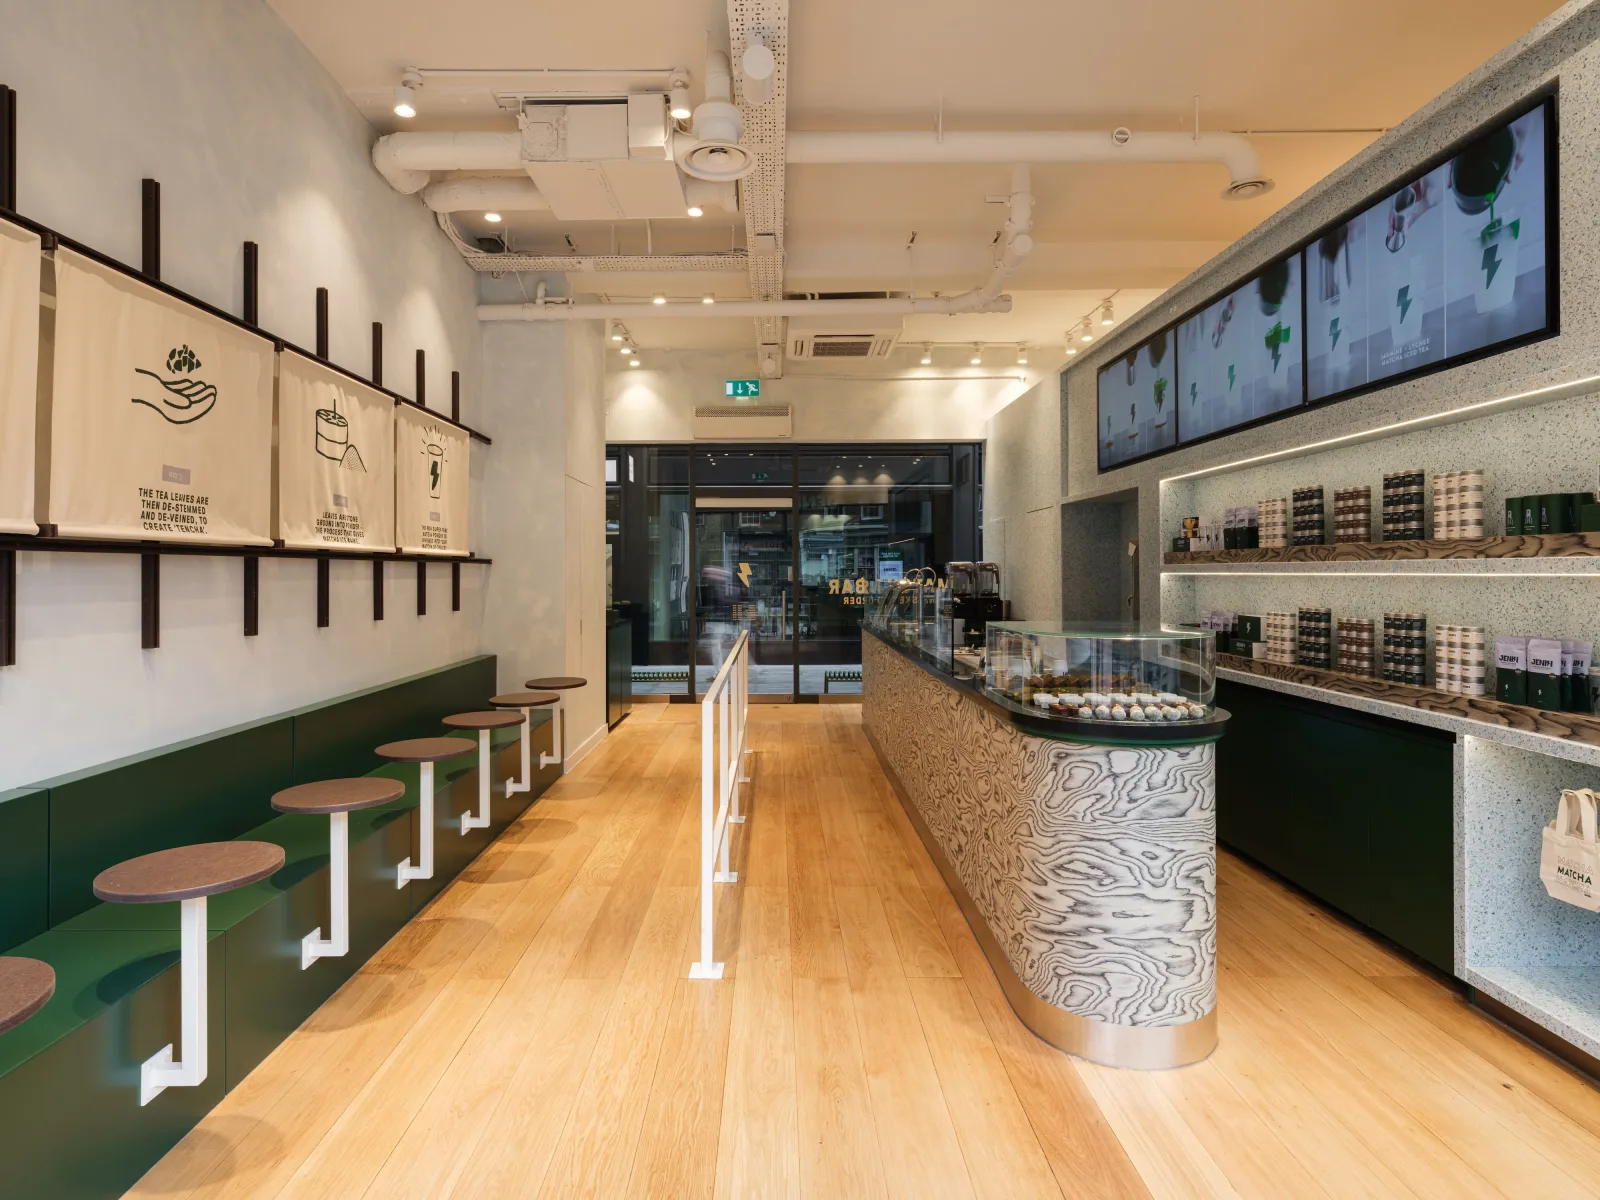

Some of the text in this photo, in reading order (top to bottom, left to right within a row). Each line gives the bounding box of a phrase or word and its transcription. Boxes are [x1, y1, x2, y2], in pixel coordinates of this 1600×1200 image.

[1380, 347, 1403, 360] JASMINE
[1408, 337, 1430, 350] LYCHEE
[1381, 345, 1430, 366] MATCHA ICED TEA
[138, 487, 209, 506] THE TEA LEAVES ARE
[141, 499, 206, 515] THEN DE-STEMMED
[140, 510, 208, 525] AND DE-VEINED, TO
[316, 518, 334, 528] GROUND
[335, 521, 346, 529] INTO
[143, 521, 174, 532] CREATE
[315, 526, 323, 534] THE
[1531, 658, 1553, 667] JENKI
[1557, 866, 1592, 885] MATCHA
